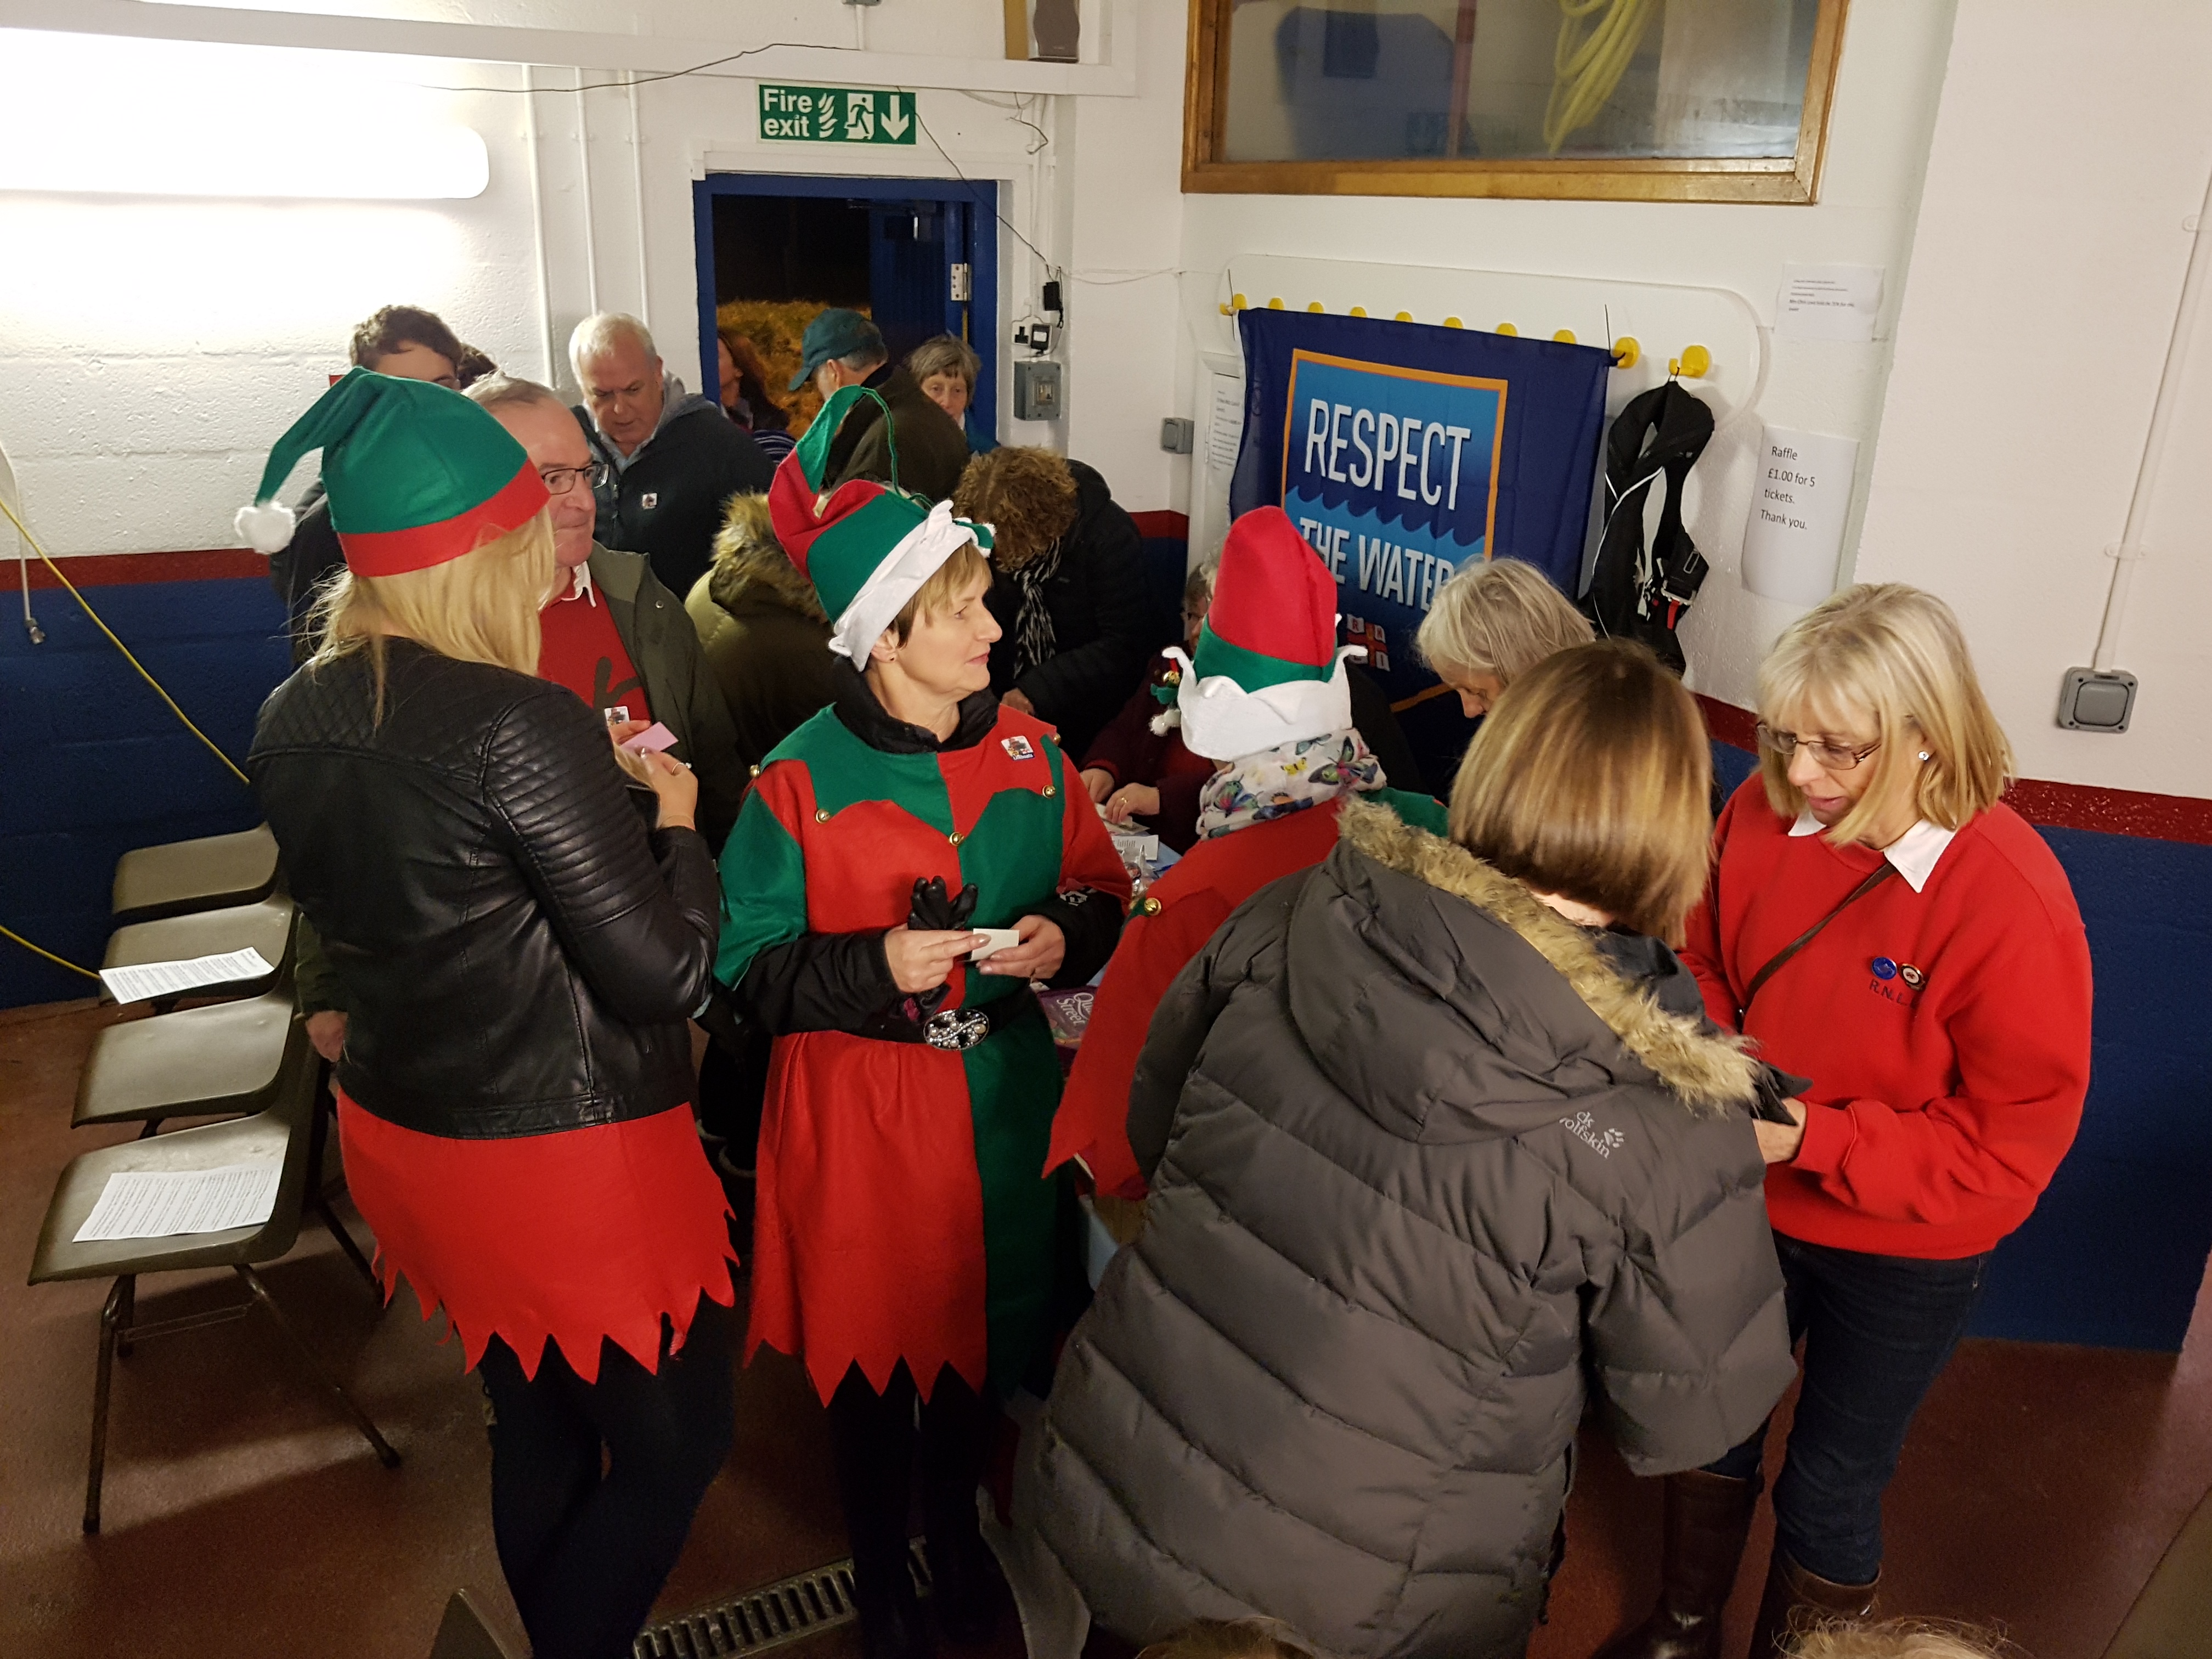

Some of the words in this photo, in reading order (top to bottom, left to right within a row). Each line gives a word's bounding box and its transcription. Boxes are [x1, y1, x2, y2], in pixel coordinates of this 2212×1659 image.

[763, 88, 812, 113] Fire
[764, 114, 810, 137] exit
[1305, 398, 1471, 511] RESPECT
[1771, 446, 1798, 460] Raffle
[1768, 468, 1793, 482] £1.00
[1795, 473, 1808, 486] for
[1809, 476, 1815, 487] 5
[1764, 488, 1795, 504] tickets.
[1760, 509, 1786, 525] Thank
[1788, 518, 1807, 530] you.
[1300, 517, 1350, 584] THE
[1359, 534, 1455, 613] WATER
[1057, 998, 1086, 1027] Street
